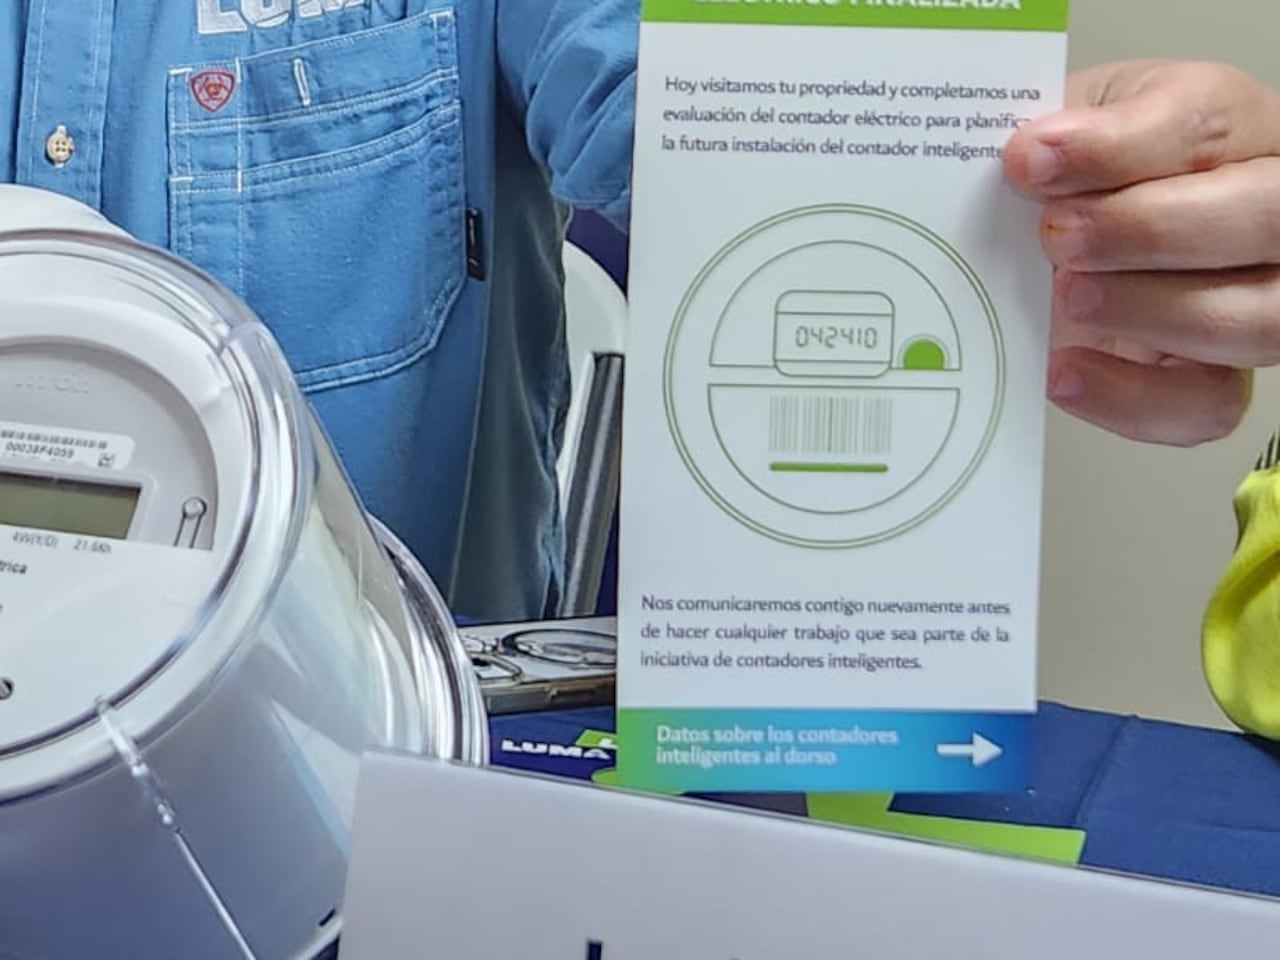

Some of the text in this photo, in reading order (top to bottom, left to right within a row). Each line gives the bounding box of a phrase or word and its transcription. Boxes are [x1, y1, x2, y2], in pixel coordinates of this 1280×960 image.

[665, 76, 1041, 102] Hoy visitamos tu propriedad y completamos una
[662, 106, 747, 123] evaluación
[749, 107, 775, 124] del
[778, 109, 851, 126] contador
[854, 110, 922, 127] eléctrico
[925, 115, 961, 131] para
[661, 134, 676, 151] la
[679, 134, 729, 152] futura
[731, 136, 816, 154] instalación
[819, 138, 844, 155] del
[846, 140, 918, 157] contador
[794, 325, 878, 350] 042410
[641, 594, 1011, 617] Nos comunicaremos contigo nuevamente antes
[640, 622, 1010, 645] de hacer cualquier trabajo que sea parte de la
[640, 651, 923, 673] iniciativa de contadores inteligentes.
[656, 724, 898, 745] Datos sobre los contadores
[501, 739, 612, 761] LUMA
[656, 746, 836, 769] inteligentes al dorso
